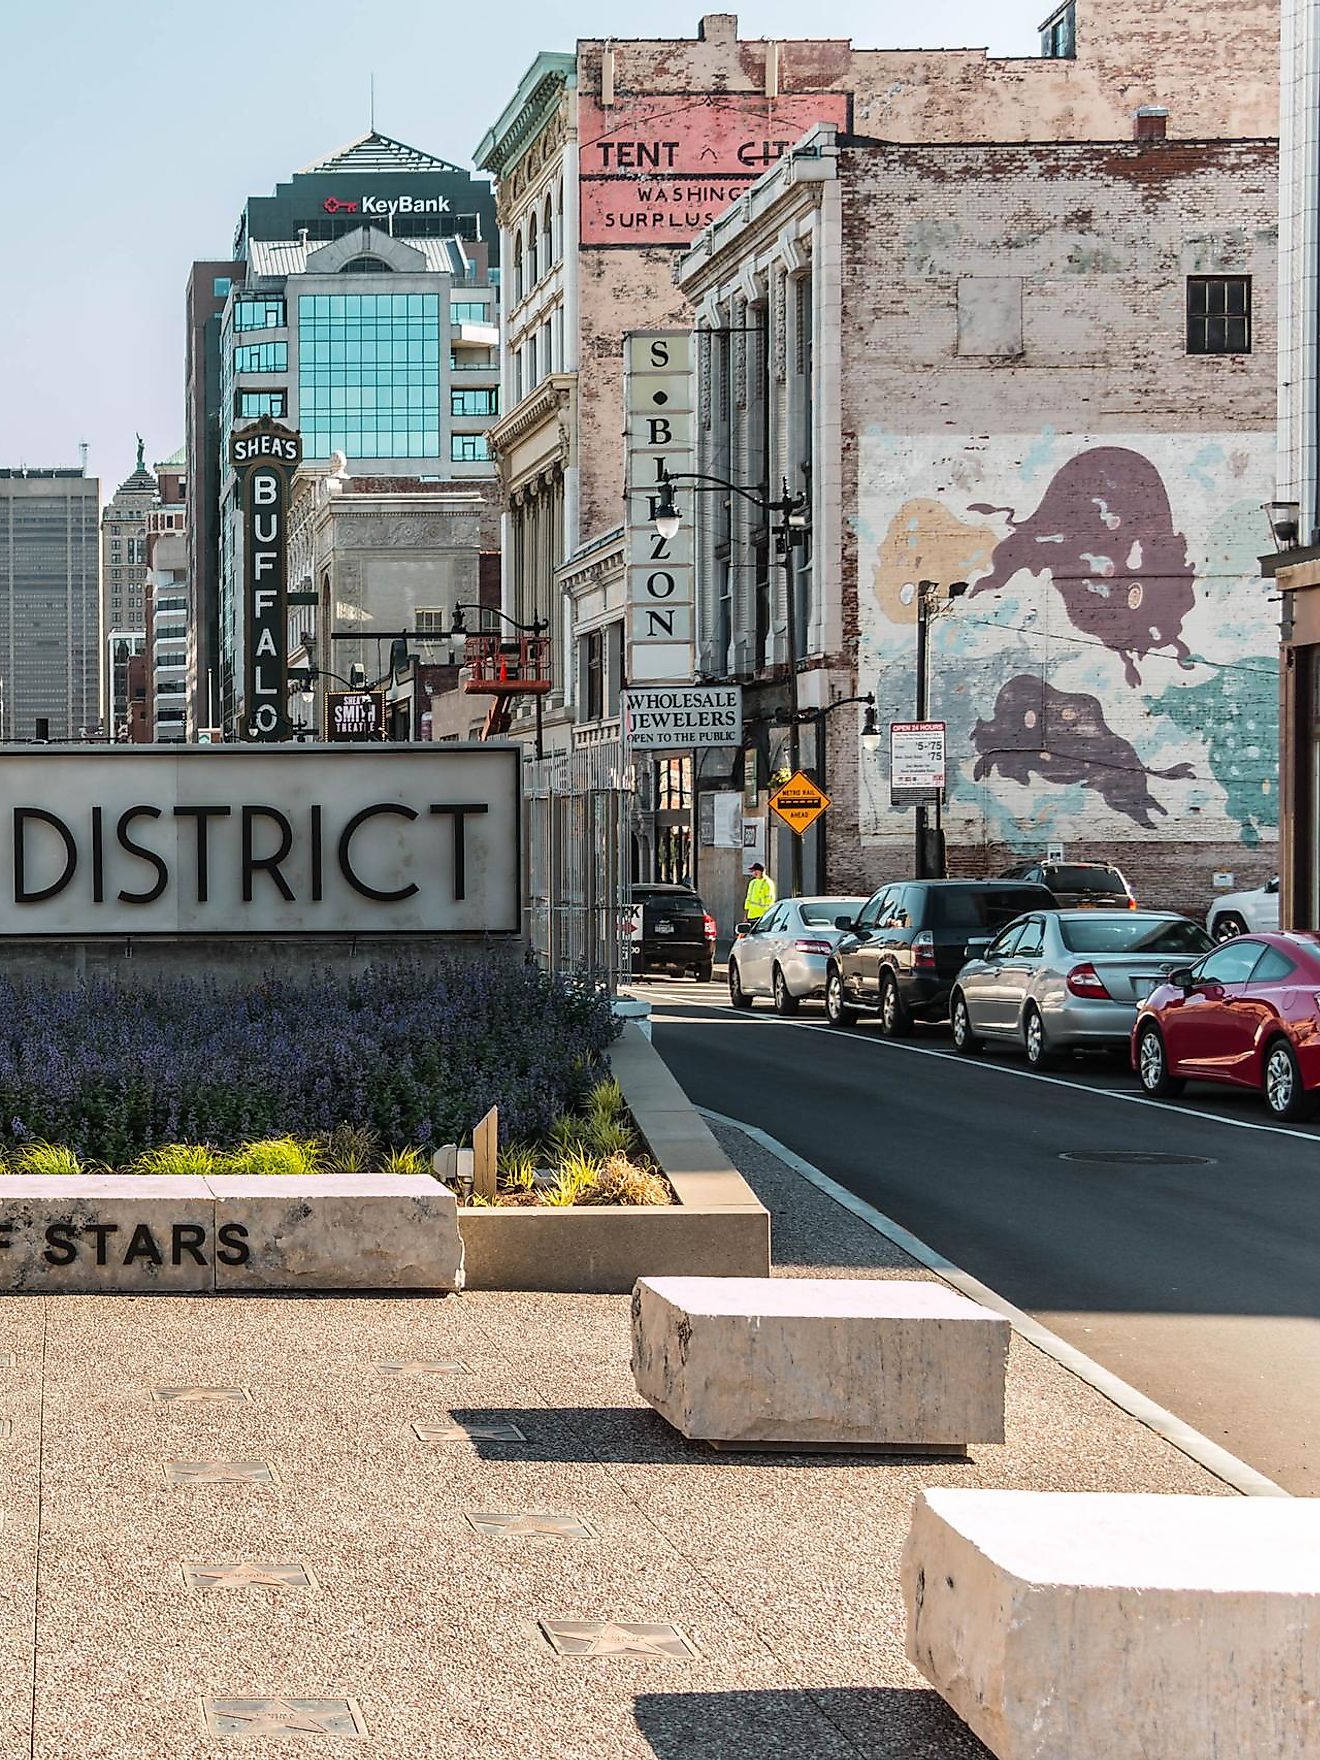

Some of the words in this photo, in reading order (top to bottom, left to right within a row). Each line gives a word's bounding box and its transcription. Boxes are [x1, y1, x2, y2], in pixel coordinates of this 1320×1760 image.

[596, 142, 679, 167] TENT
[362, 195, 450, 216] KeyBank
[605, 212, 714, 229] SURPLUS
[234, 435, 297, 461] SHEA'S
[254, 476, 278, 733] BUFFALO
[627, 692, 737, 711] WHOLESALE
[630, 711, 736, 732] JEWELERS
[627, 733, 654, 743] OPEN
[657, 733, 672, 742] TO
[674, 732, 696, 742] THE
[700, 731, 736, 741] PUBLIC
[13, 803, 488, 903] DISTRICT
[44, 1223, 250, 1266] STARS
